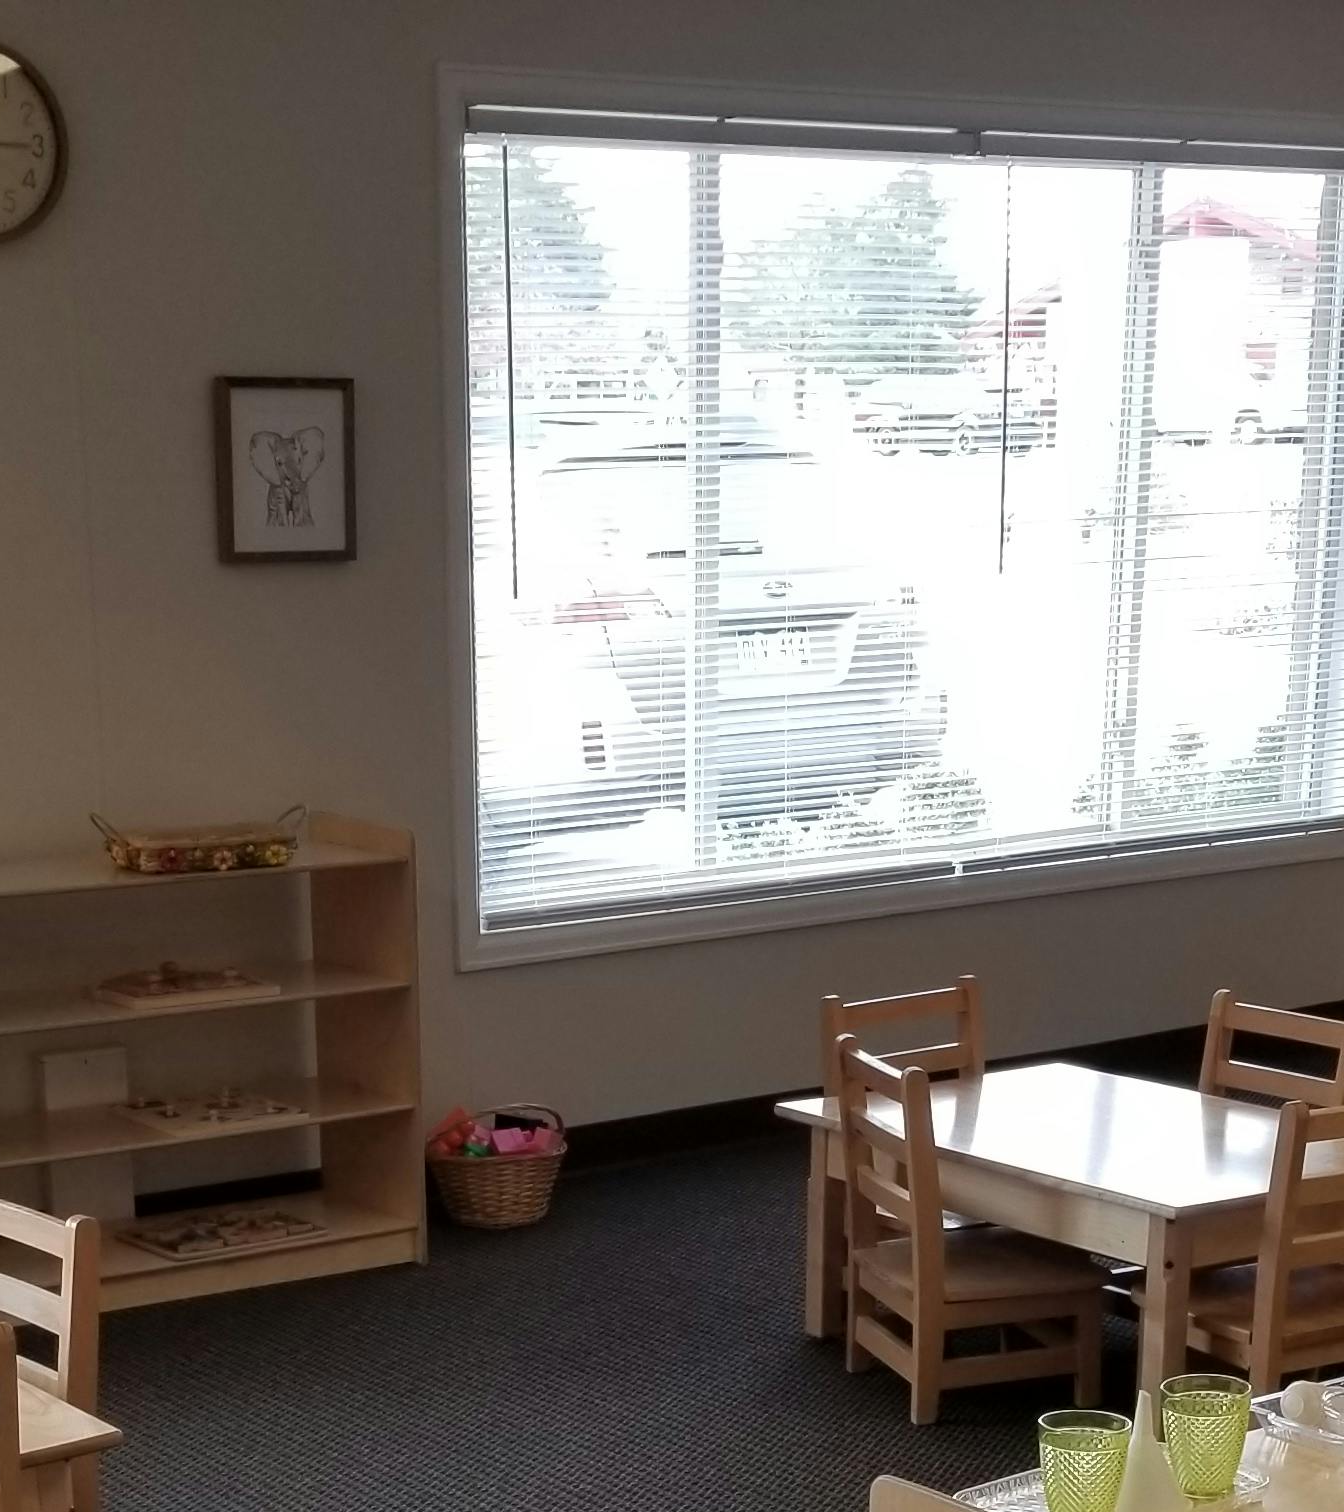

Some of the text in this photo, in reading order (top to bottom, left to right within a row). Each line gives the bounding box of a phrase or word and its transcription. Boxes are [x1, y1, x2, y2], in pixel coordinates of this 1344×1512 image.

[20, 102, 33, 126] 2
[32, 134, 44, 158] 3
[22, 167, 36, 189] 4
[3, 189, 16, 214] 5
